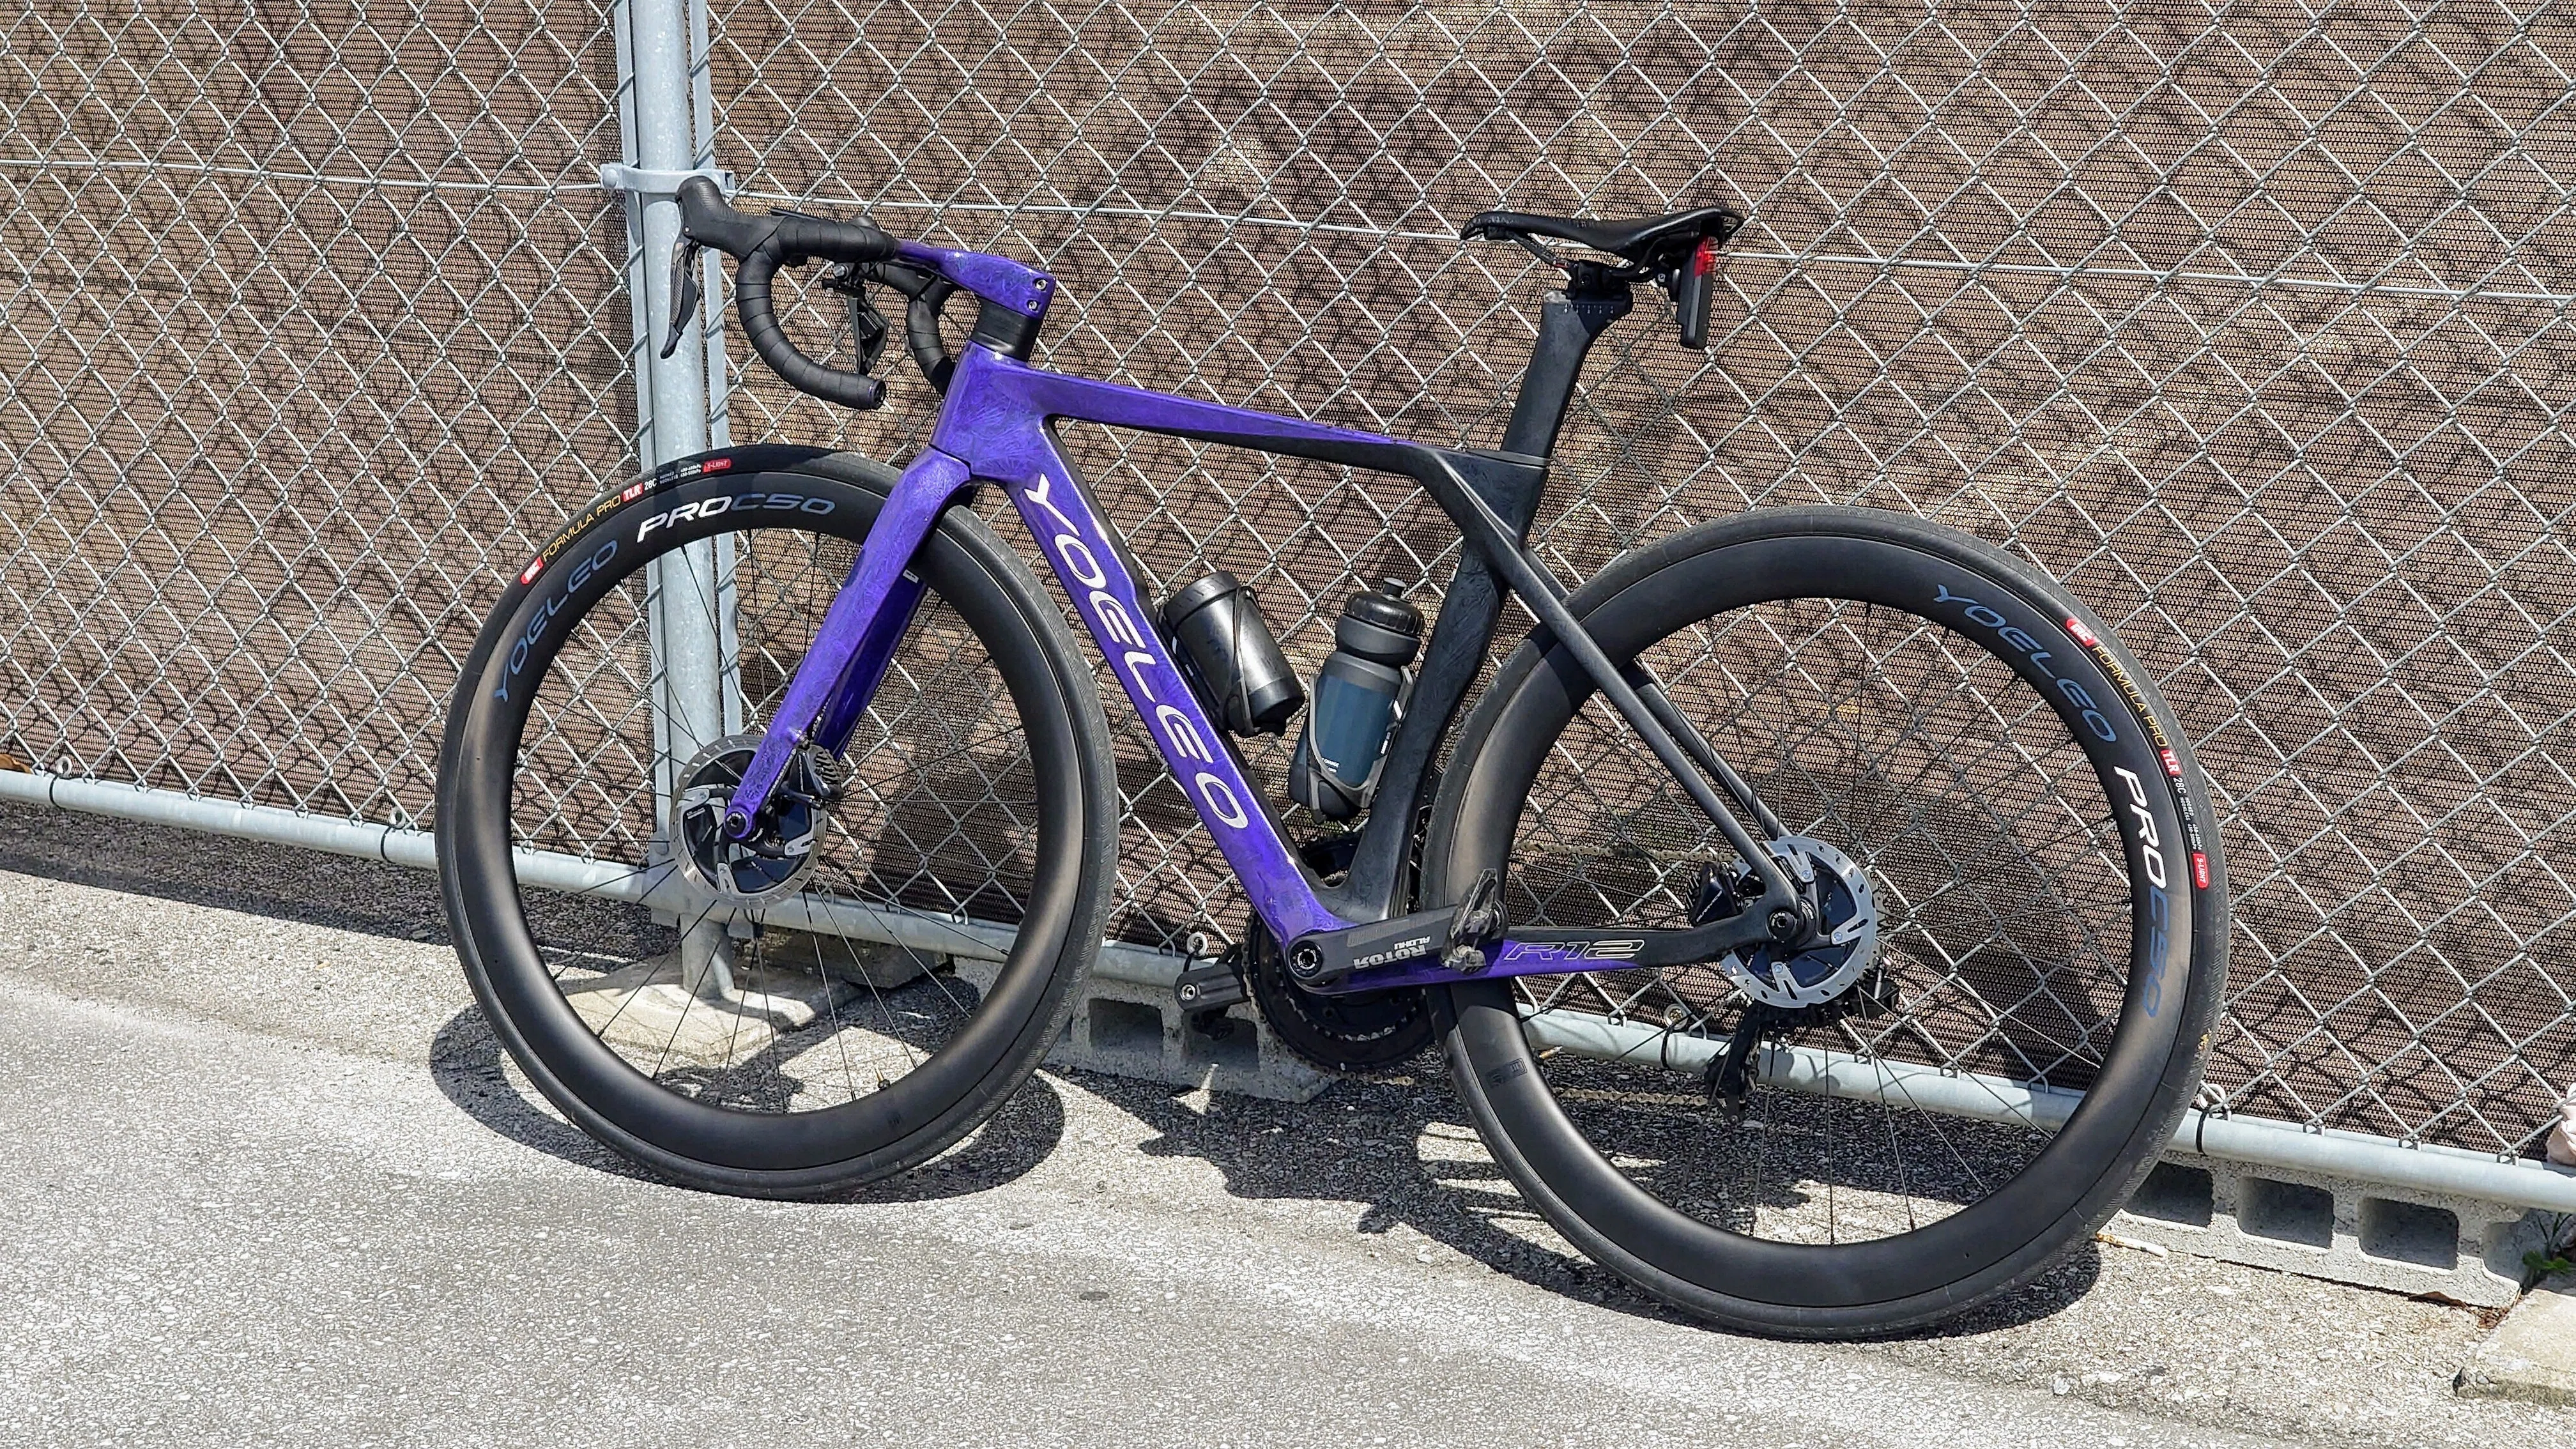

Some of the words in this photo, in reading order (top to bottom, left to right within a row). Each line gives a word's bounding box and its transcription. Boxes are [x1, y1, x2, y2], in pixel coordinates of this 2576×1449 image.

[707, 461, 728, 470] S-LIGHT
[542, 513, 595, 562] FORMULA
[596, 495, 622, 517] PRO
[623, 484, 642, 502] TLR
[644, 479, 657, 491] 28C
[494, 540, 618, 703] YOELEO
[1024, 473, 1248, 829] YOELEO
[1934, 583, 2117, 742] YOELEO
[2092, 645, 2147, 713] FORMULA
[2143, 715, 2168, 747] PRO
[2162, 751, 2180, 773] TLR
[2173, 777, 2187, 794] 28C
[2196, 857, 2206, 884] S-LIGHT
[1353, 944, 1427, 969] ROTOR
[1394, 935, 1431, 951] ALDHU
[1504, 939, 1645, 960] R12
